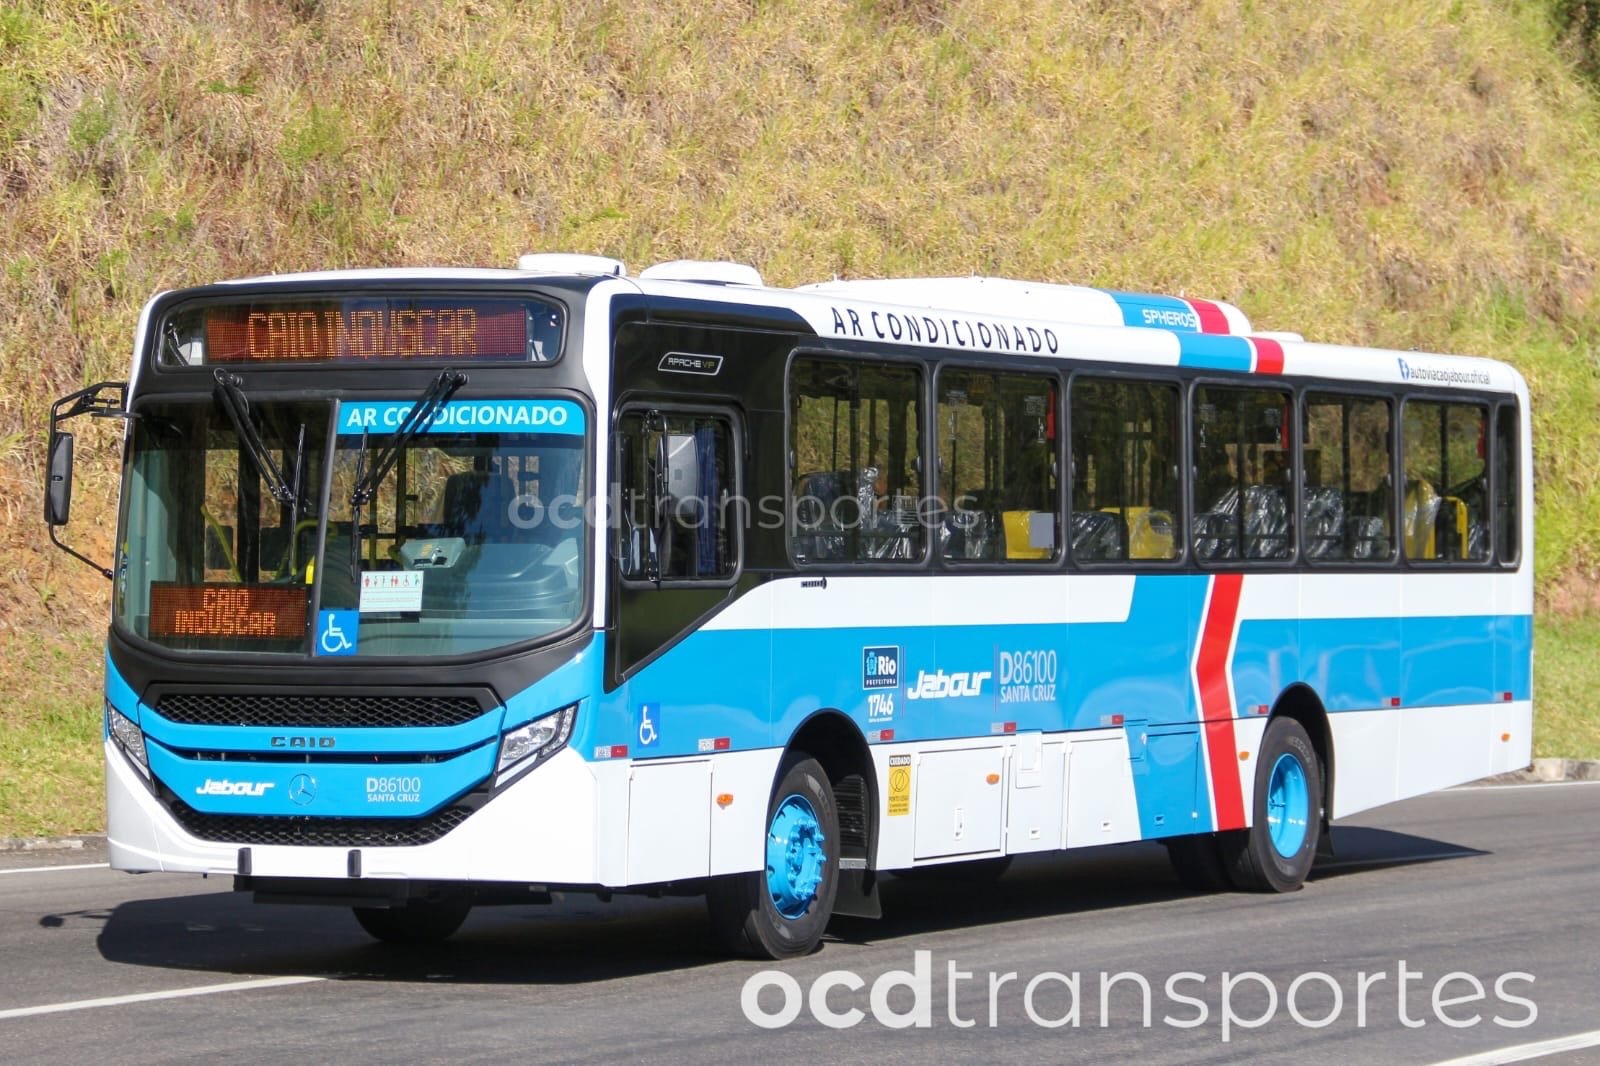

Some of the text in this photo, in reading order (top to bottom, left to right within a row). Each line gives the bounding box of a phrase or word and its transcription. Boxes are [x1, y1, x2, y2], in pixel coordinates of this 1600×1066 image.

[1142, 309, 1196, 328] SPHEROS
[248, 311, 318, 358] CAIO
[833, 307, 1059, 354] AR CONDICIONADO
[668, 357, 701, 368] APACHE
[347, 406, 567, 427] AR CODICIONADO
[202, 589, 249, 609] CAIO
[175, 610, 276, 635] INDUSCAR
[878, 655, 896, 676] Rio
[1000, 649, 1057, 685] D86100
[907, 669, 991, 700] Jabour
[1000, 684, 1056, 703] SANTA CRUZ
[868, 693, 894, 717] 1746
[271, 736, 335, 748] CAIO
[196, 779, 275, 796] Jabour
[366, 777, 421, 793] D86100
[367, 794, 420, 802] SANTA CRUZ
